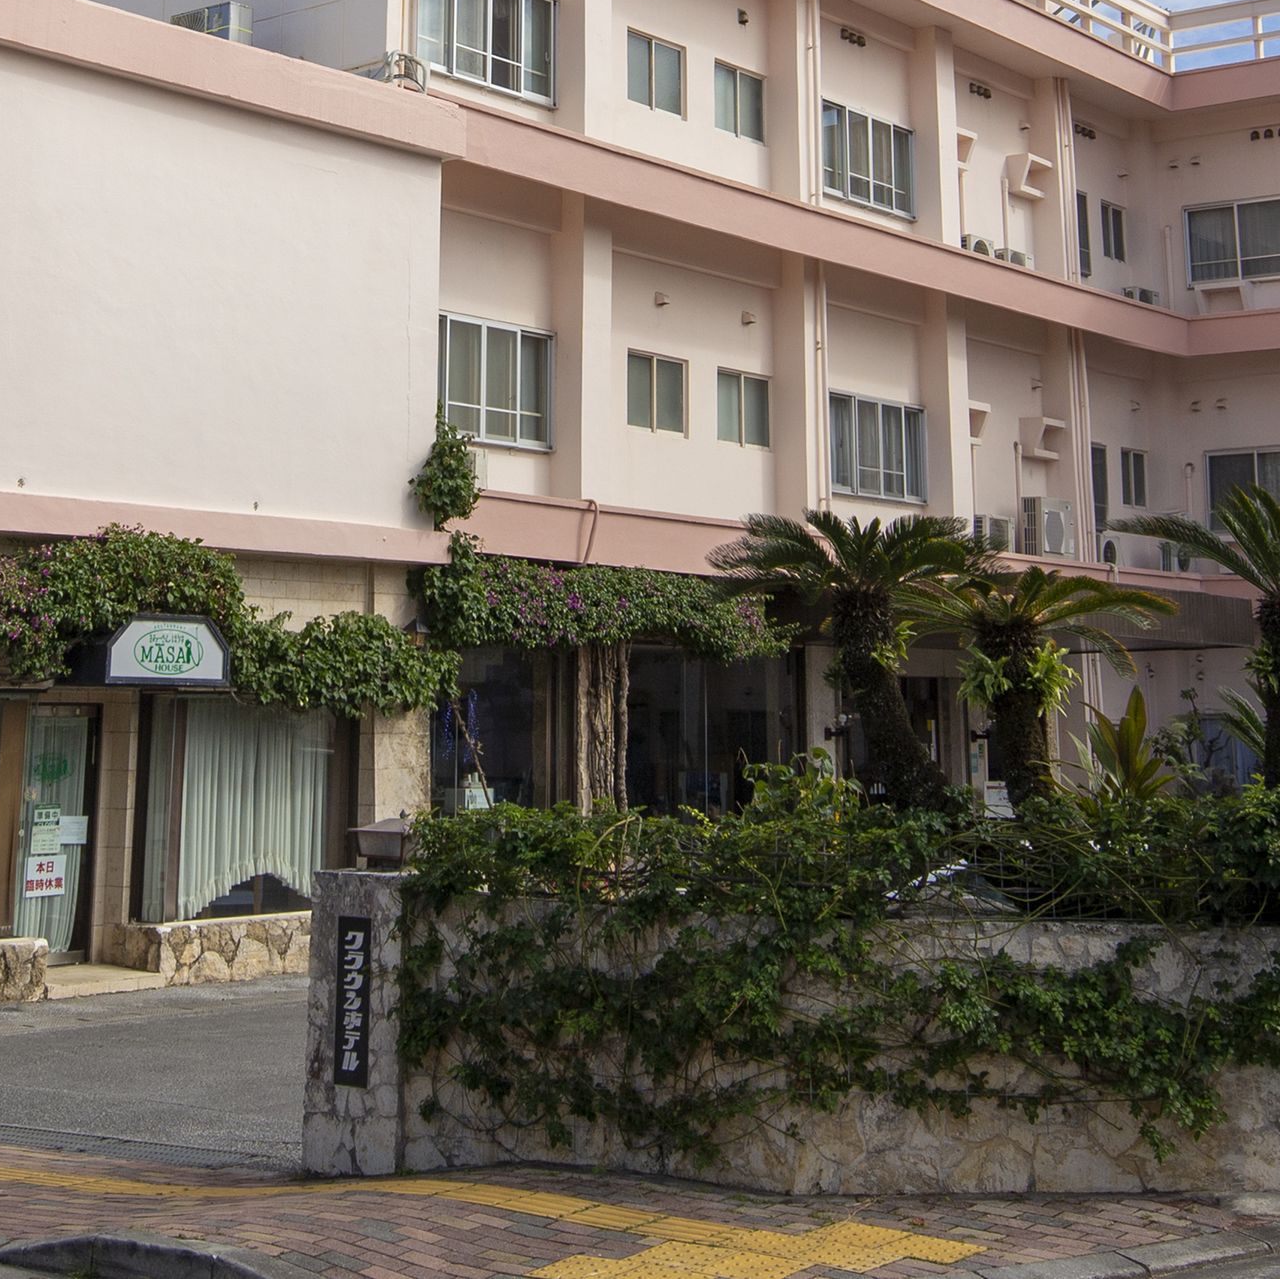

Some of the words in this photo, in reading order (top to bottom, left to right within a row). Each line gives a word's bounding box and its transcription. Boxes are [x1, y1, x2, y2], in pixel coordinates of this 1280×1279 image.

[155, 664, 183, 672] HOUSE
[36, 861, 54, 874] 本日
[25, 877, 63, 892] 臨時休業
[341, 931, 365, 1072] クラウンホテル
